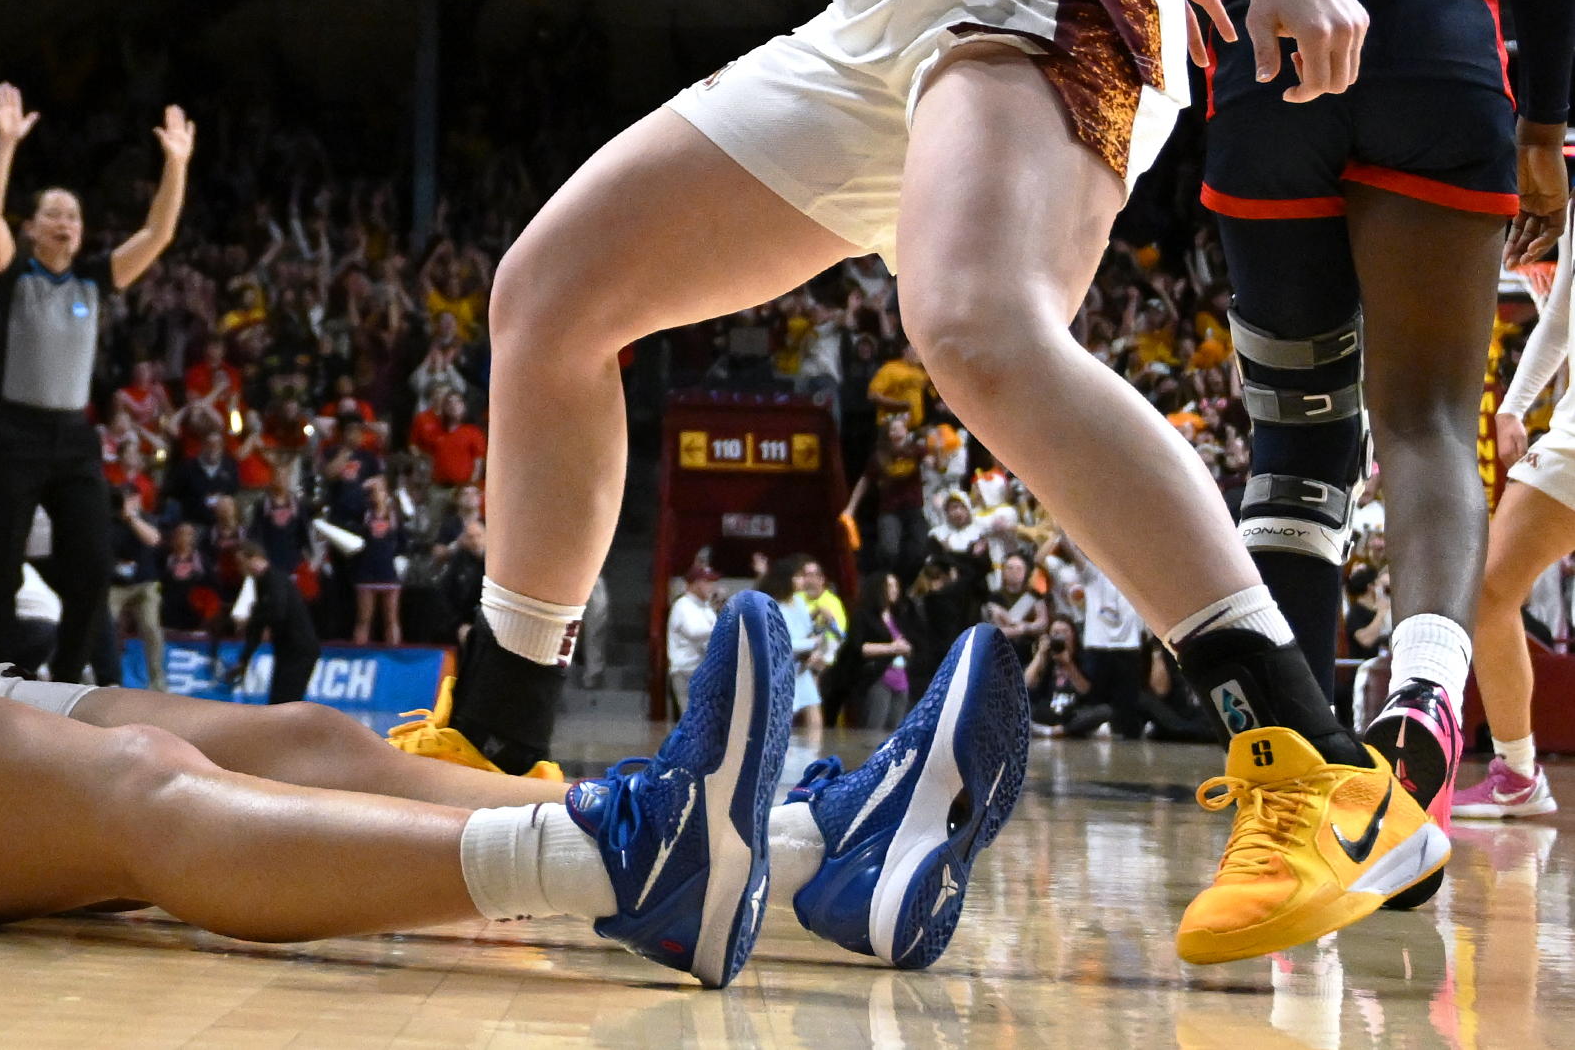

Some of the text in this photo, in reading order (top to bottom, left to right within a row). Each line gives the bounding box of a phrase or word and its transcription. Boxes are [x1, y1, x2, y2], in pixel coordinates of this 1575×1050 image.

[712, 437, 788, 462] 110 111
[1242, 526, 1307, 538] DONJOY
